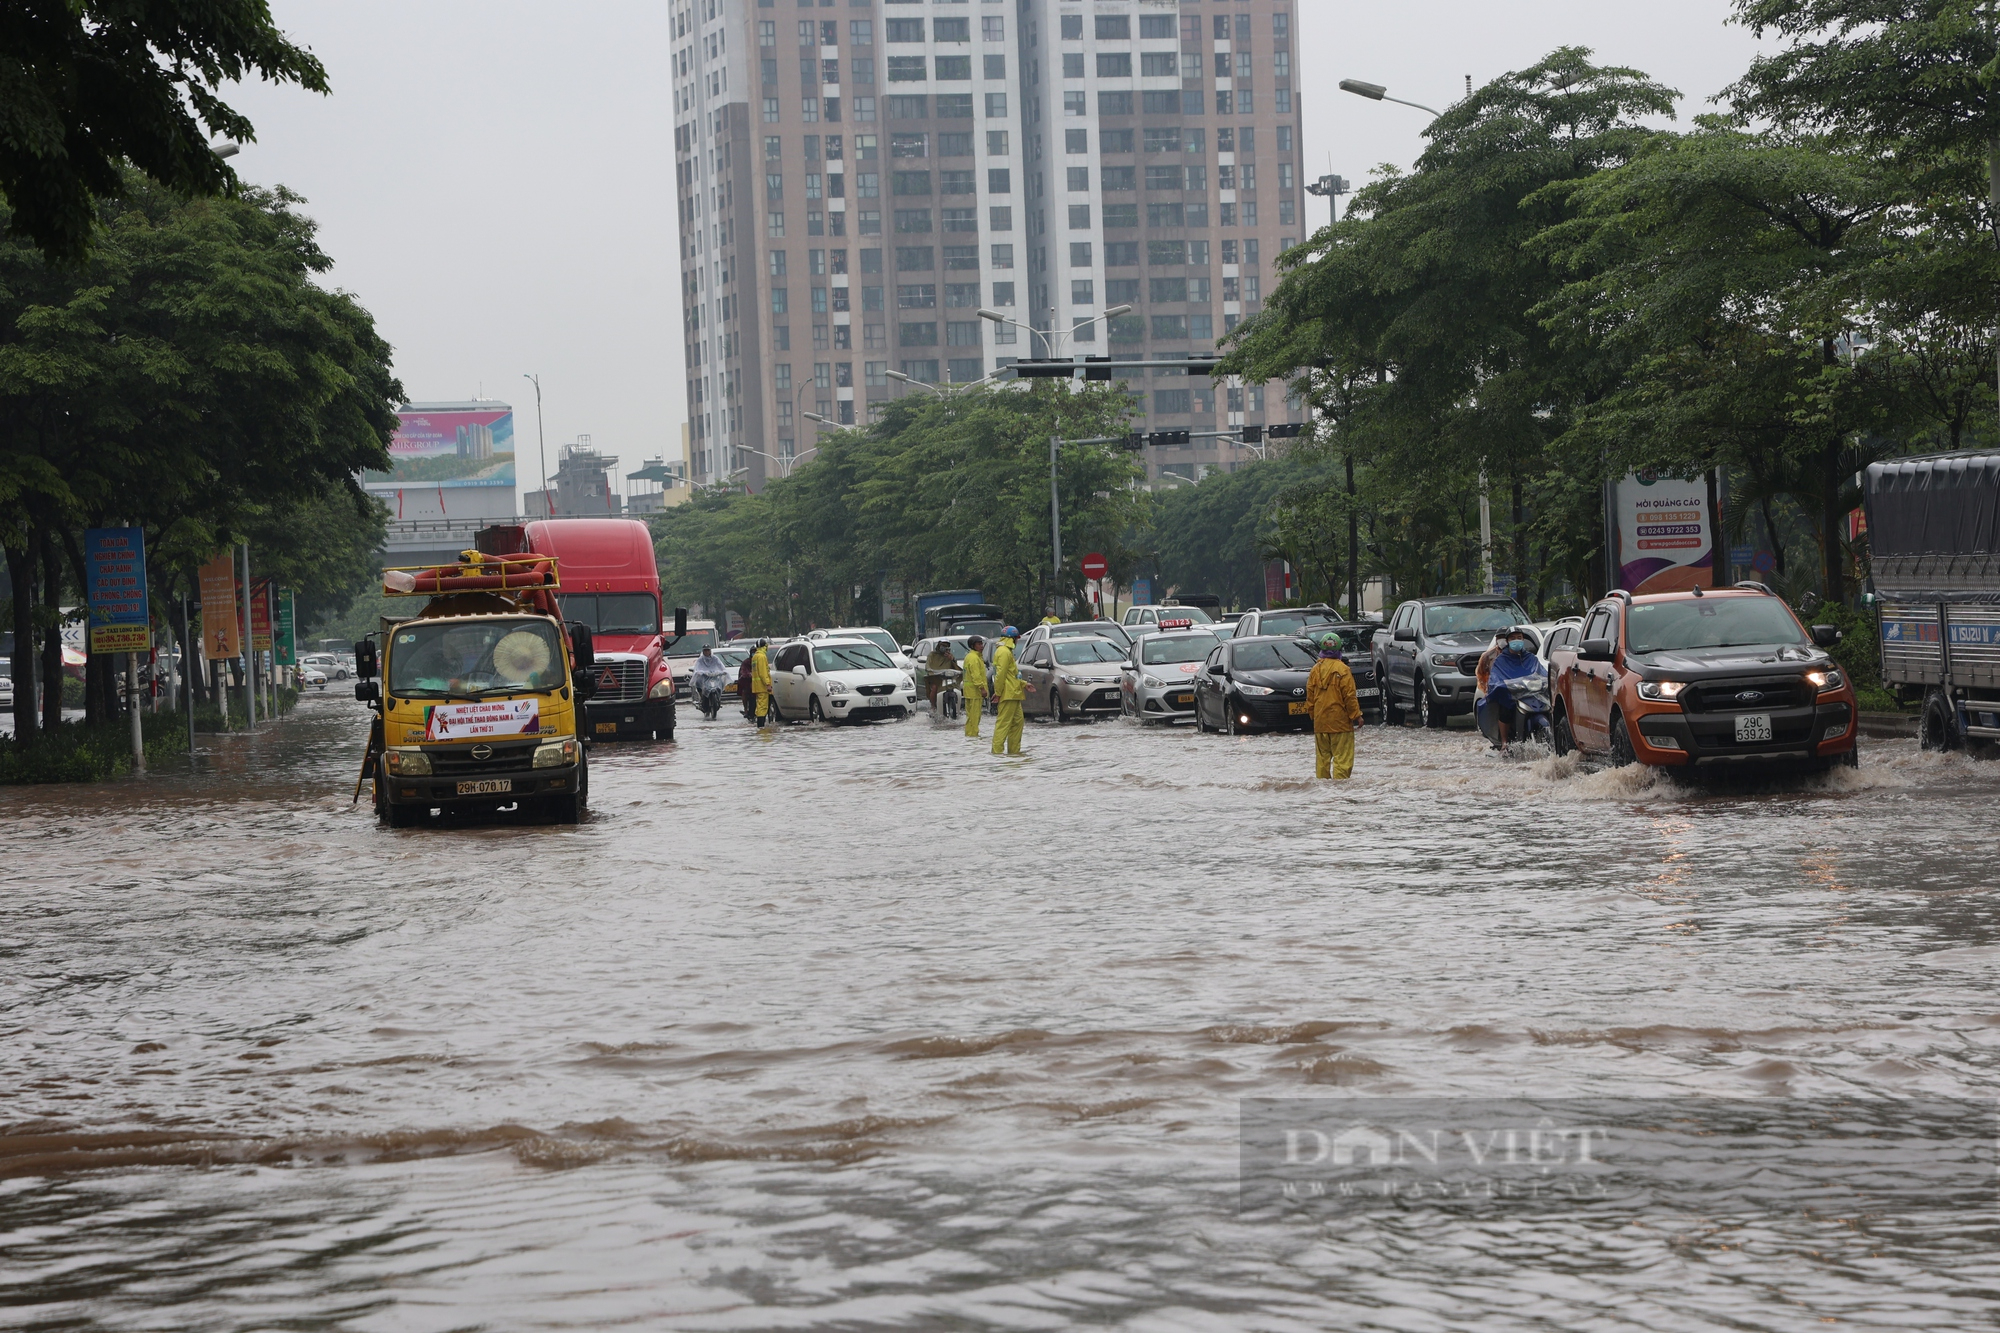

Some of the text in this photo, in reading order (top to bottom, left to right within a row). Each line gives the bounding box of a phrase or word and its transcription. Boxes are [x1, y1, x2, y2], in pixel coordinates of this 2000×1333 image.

[392, 441, 440, 449] MIKGROUP
[1635, 497, 1700, 508] MỜI QUẢNG CÁO
[1679, 512, 1696, 520] 1229
[1648, 525, 1699, 535] 0243 9722 353
[99, 535, 129, 548] TOÀN DÂN
[93, 550, 117, 561] NGHIÊM
[99, 561, 133, 575] CHẤP HÀNH
[96, 576, 109, 588] CÁC
[109, 577, 121, 588] QUY
[92, 587, 143, 601] VỀ PHÒNG, CHỐNG
[111, 602, 140, 613] COVID-19!
[1175, 618, 1190, 626] 123
[133, 625, 146, 633] BIÊN
[1958, 626, 1982, 642] ISUZU
[455, 703, 506, 715] NHIỆT LIỆT CHÀO MỪNG
[448, 717, 457, 726] ĐẠI
[457, 716, 466, 725] HỘI
[465, 714, 474, 724] THỂ
[474, 716, 487, 724] THAO
[486, 715, 499, 723] ĐÔNG
[498, 714, 510, 722] NAM
[1743, 716, 1763, 729] 29C
[469, 725, 479, 734] LẦN
[1736, 727, 1771, 741] 539.23
